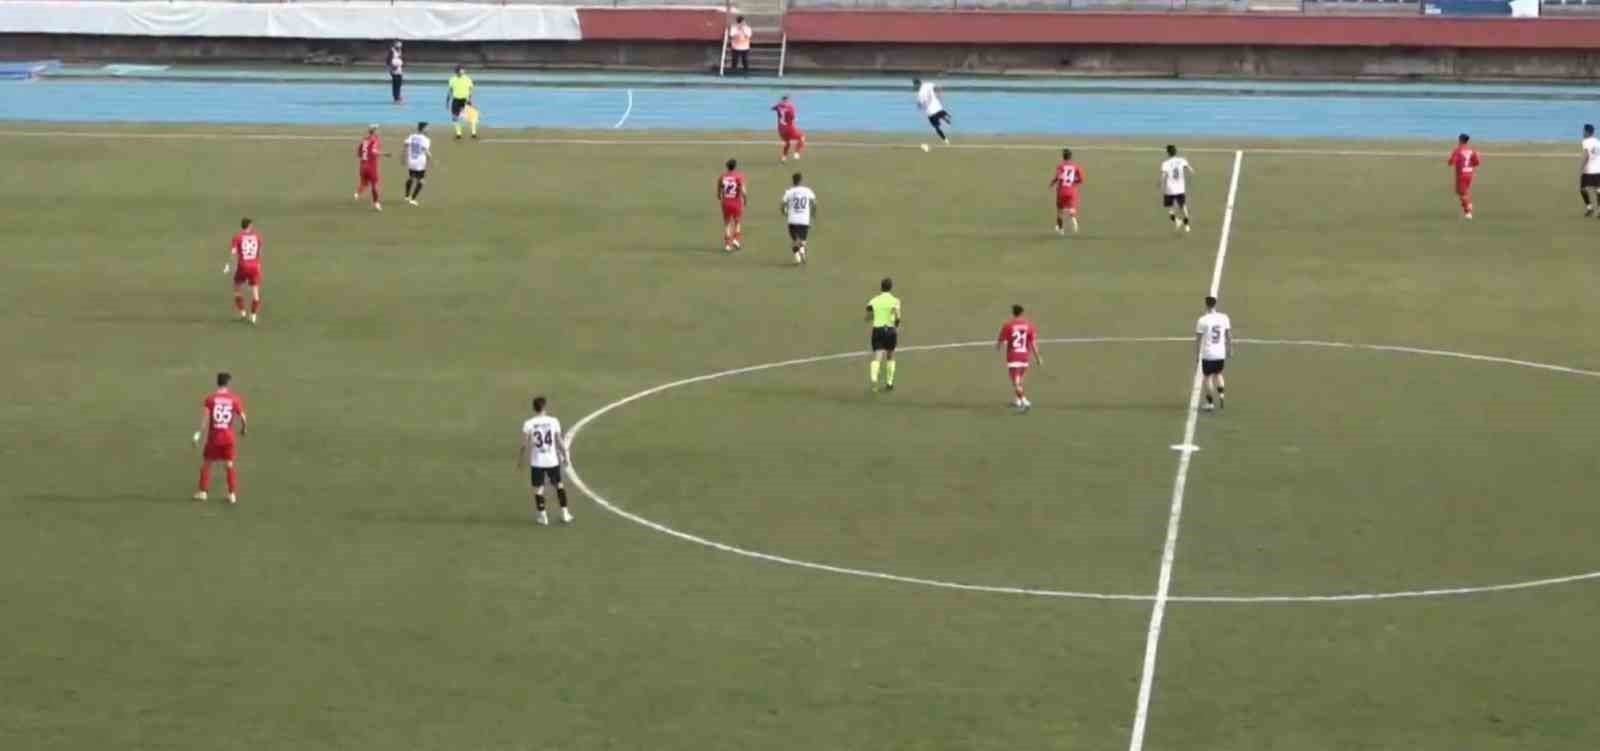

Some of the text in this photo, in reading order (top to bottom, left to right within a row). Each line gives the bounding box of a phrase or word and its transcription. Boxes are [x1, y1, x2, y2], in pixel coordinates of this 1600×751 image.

[792, 197, 807, 209] 20
[1011, 331, 1026, 348] 21
[1211, 325, 1220, 340] 5
[213, 404, 232, 423] 65
[533, 430, 552, 448] 34
